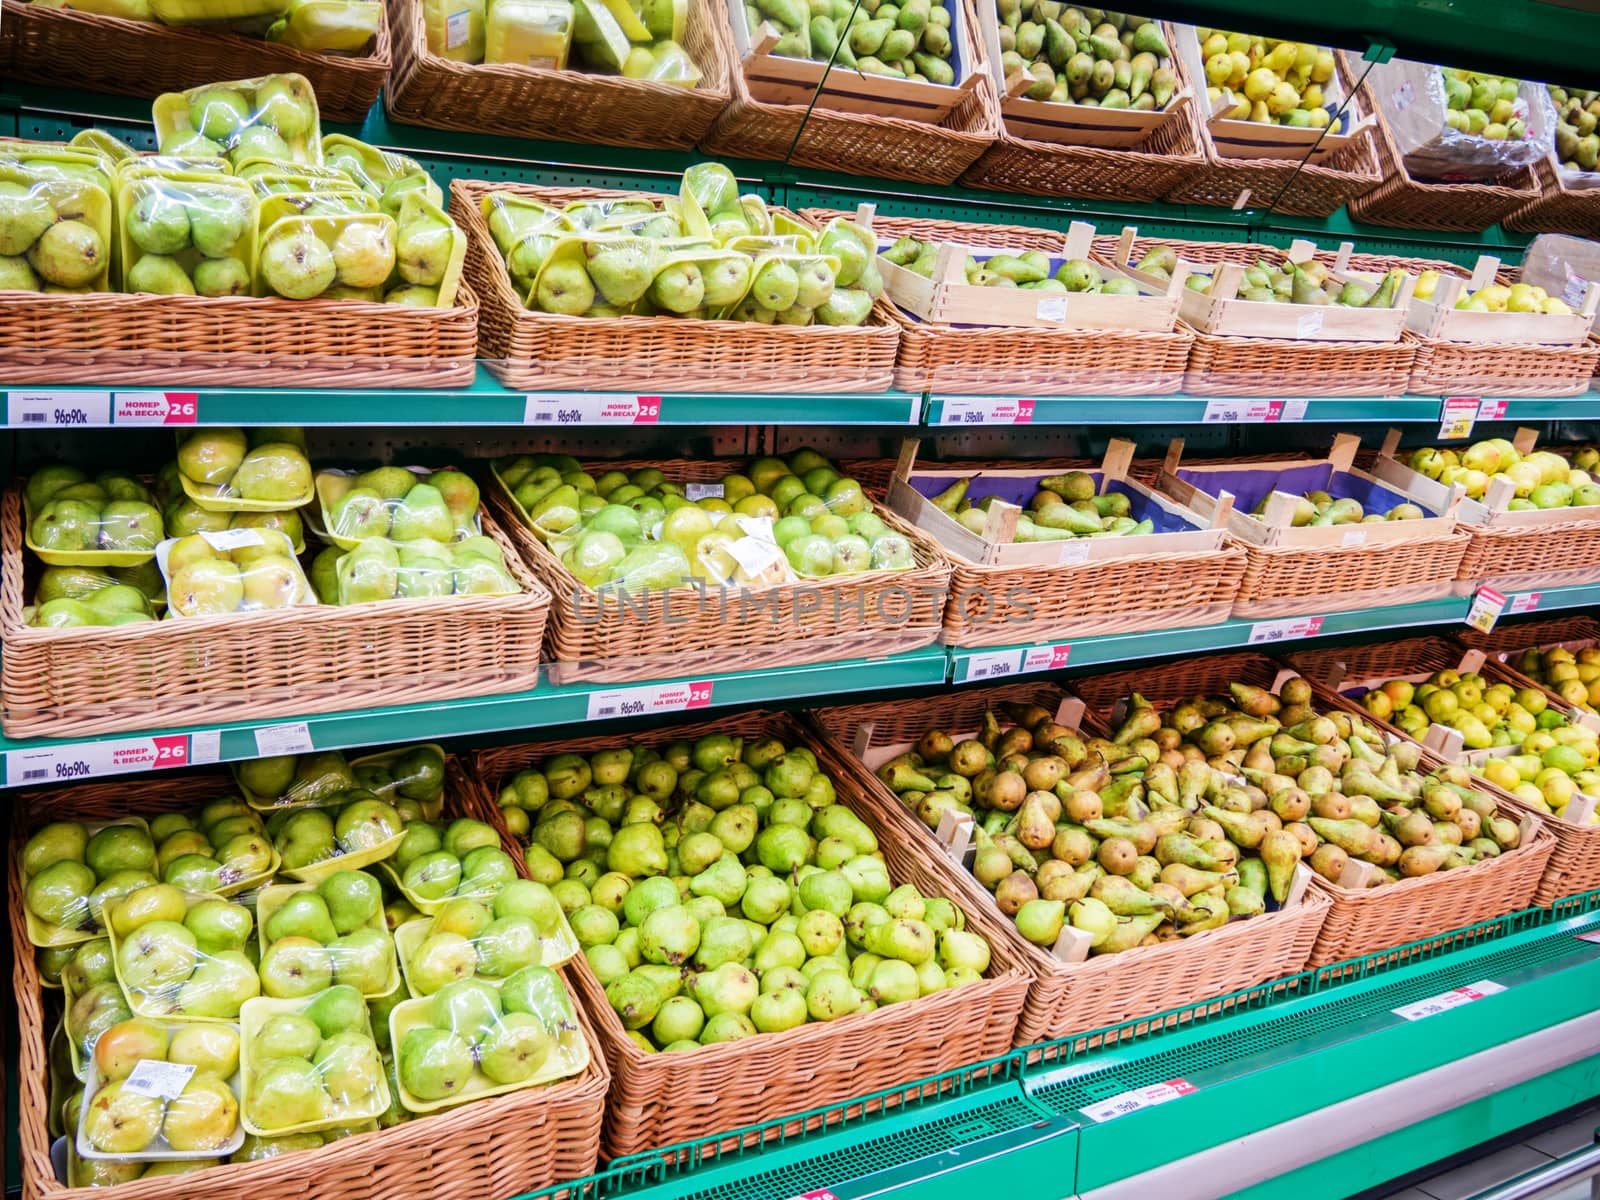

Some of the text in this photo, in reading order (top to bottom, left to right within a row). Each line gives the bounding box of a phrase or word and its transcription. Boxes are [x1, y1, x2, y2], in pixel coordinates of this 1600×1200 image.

[170, 403, 194, 415] 26
[640, 405, 658, 416] 26
[1019, 407, 1033, 416] 22
[1269, 408, 1280, 416] 22
[1055, 652, 1069, 661] 22
[659, 691, 685, 699] НОМЕР
[691, 689, 709, 701] 26
[159, 745, 185, 758] 26
[122, 755, 154, 764] ВЕСАХ
[1174, 1081, 1193, 1091] 22
